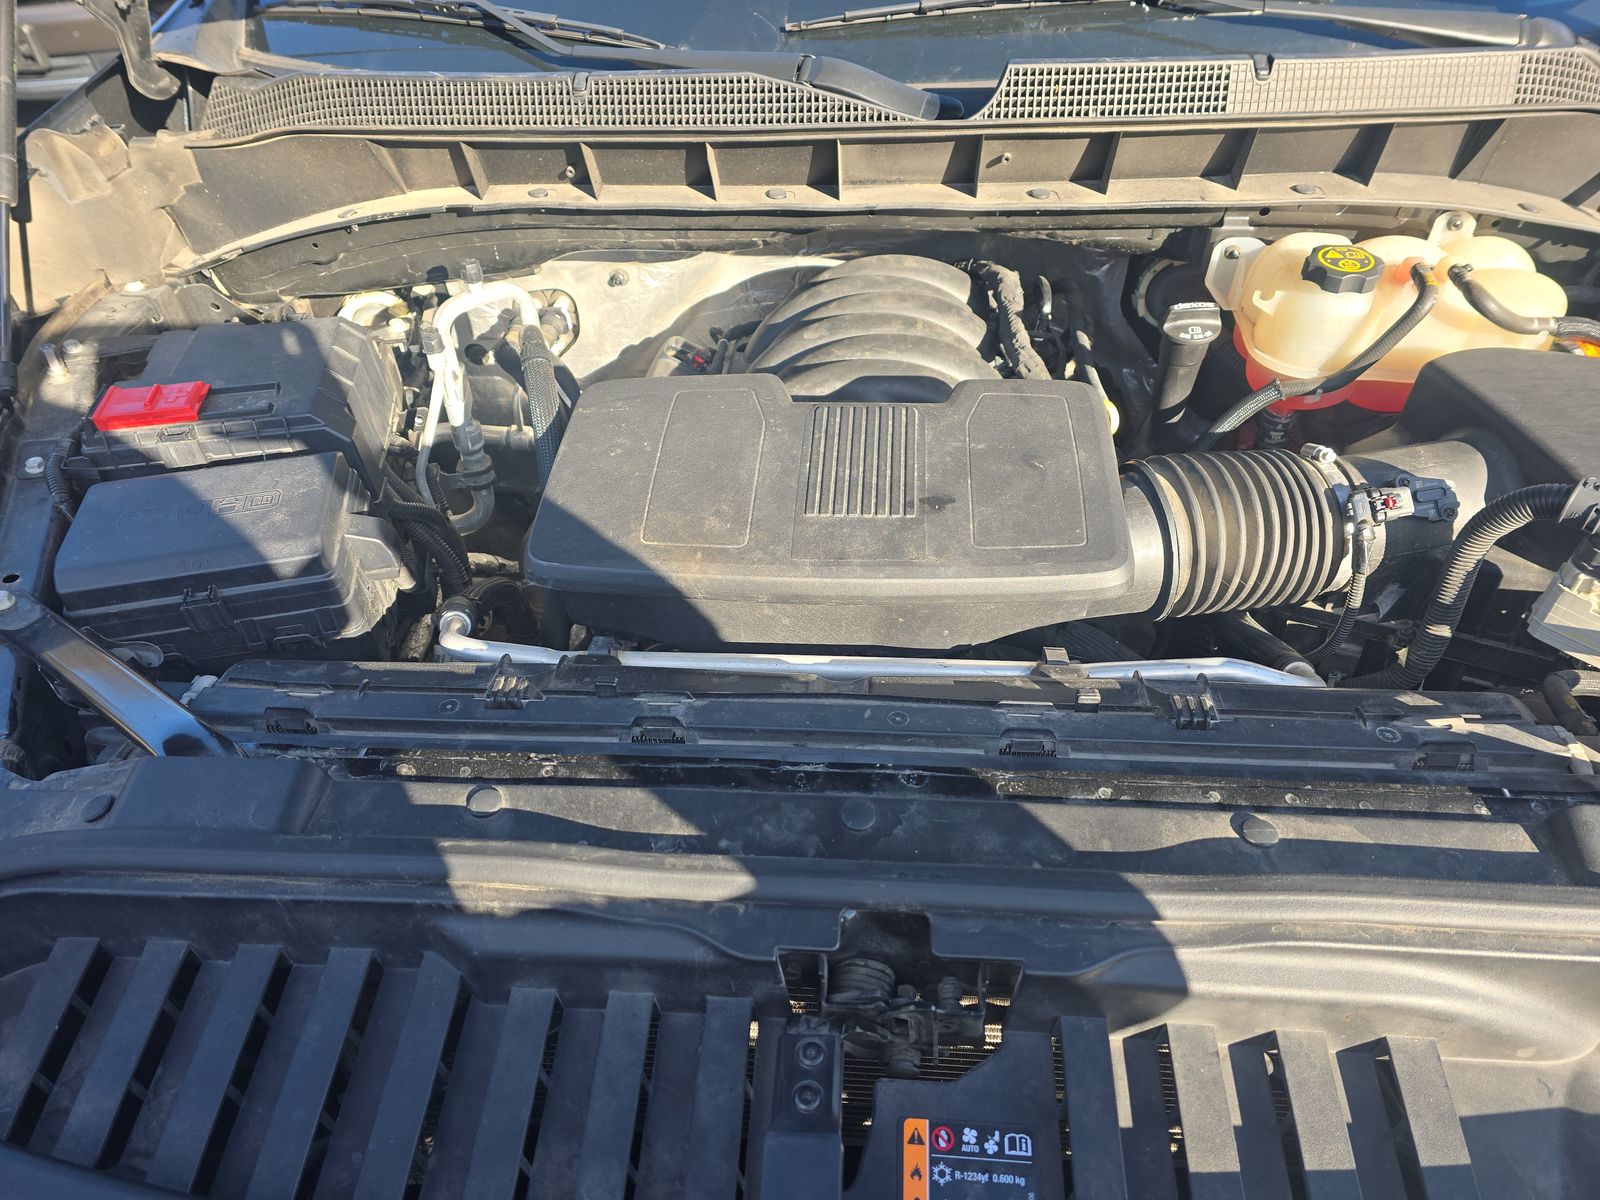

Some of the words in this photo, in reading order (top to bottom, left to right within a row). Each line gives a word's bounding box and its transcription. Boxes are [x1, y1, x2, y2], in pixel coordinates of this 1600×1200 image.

[961, 1144, 979, 1153] AUTO
[954, 1170, 989, 1184] R-1234yf
[992, 1173, 1015, 1184] 0.600
[1015, 1175, 1026, 1186] kg
